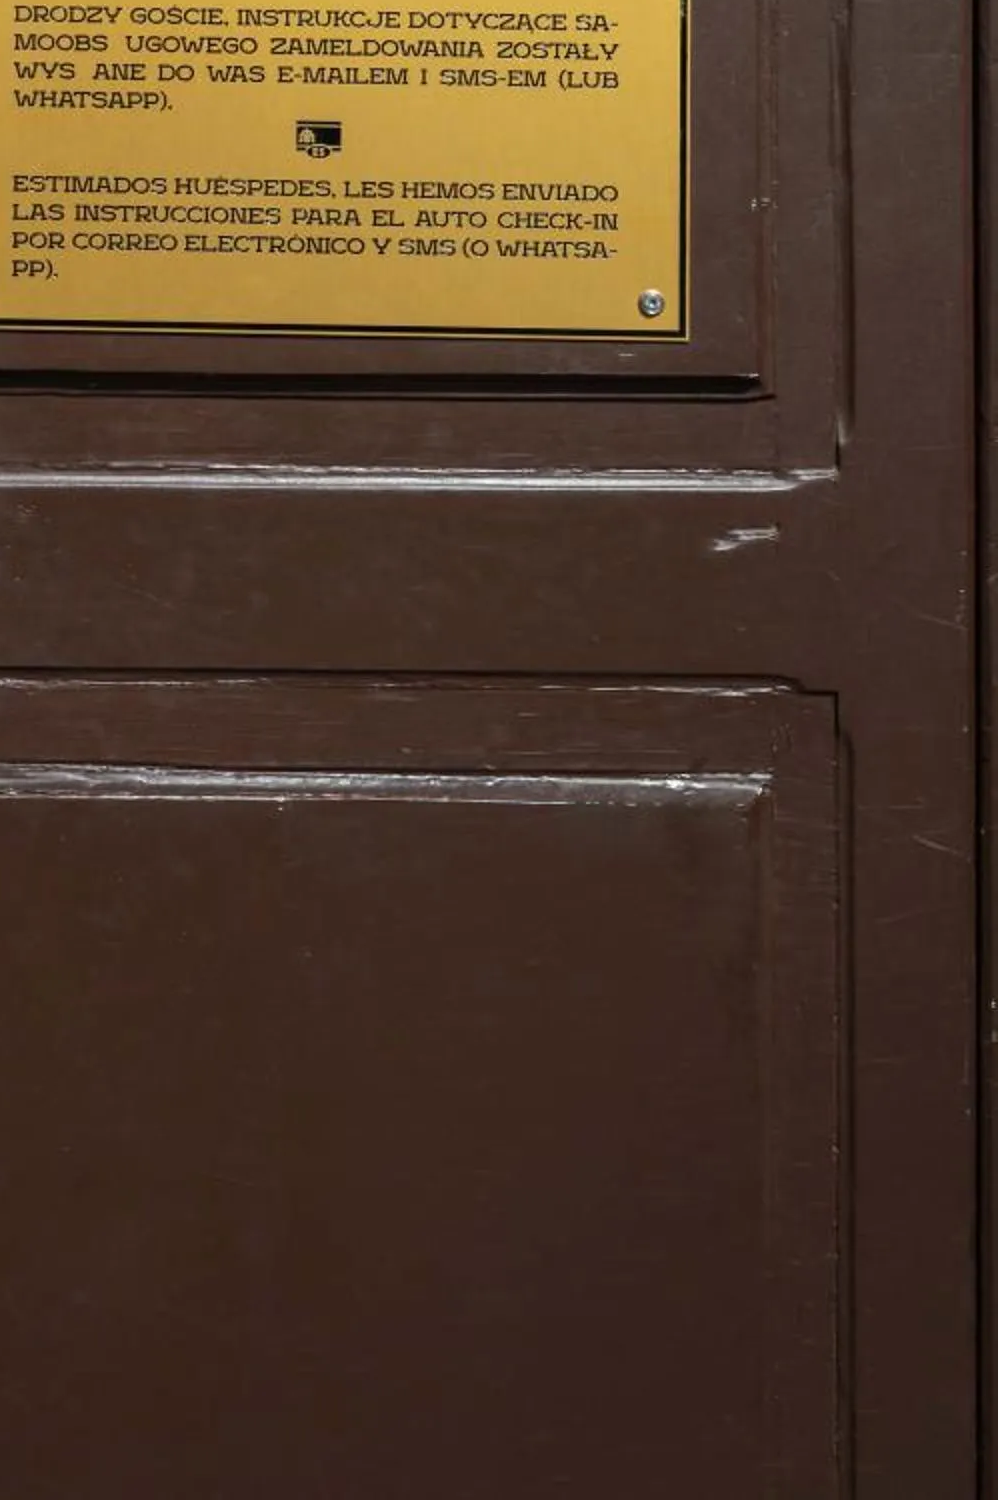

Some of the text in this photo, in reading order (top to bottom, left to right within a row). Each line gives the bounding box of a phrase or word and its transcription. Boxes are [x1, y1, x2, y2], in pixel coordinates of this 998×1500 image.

[13, 5, 123, 24] DRODZY
[236, 9, 401, 29] INSTRUKCJE
[575, 13, 619, 33] SA-
[13, 33, 620, 61] MOOBS UGOWEGO ZAMELDOWANIA ZOSTAŁY
[13, 60, 620, 92] WYS ANE DO WAS E-MAILEM I SMS-EM (LUB
[13, 89, 173, 111] WHATSAPP).
[12, 175, 168, 194] ESTIMADOS
[343, 179, 395, 199] LES
[401, 180, 496, 200] HEMOS
[501, 183, 619, 203] ENVIADO
[12, 202, 619, 231] LAS INSTRUCCIONES PARA EL AUTO CHECK-IN
[11, 230, 65, 250] POR
[71, 232, 179, 251] CORREO
[371, 237, 392, 256] Y
[397, 237, 457, 257] SMS
[461, 237, 490, 259] (O
[495, 240, 618, 259] WHATSA-
[11, 259, 59, 280] PP).
